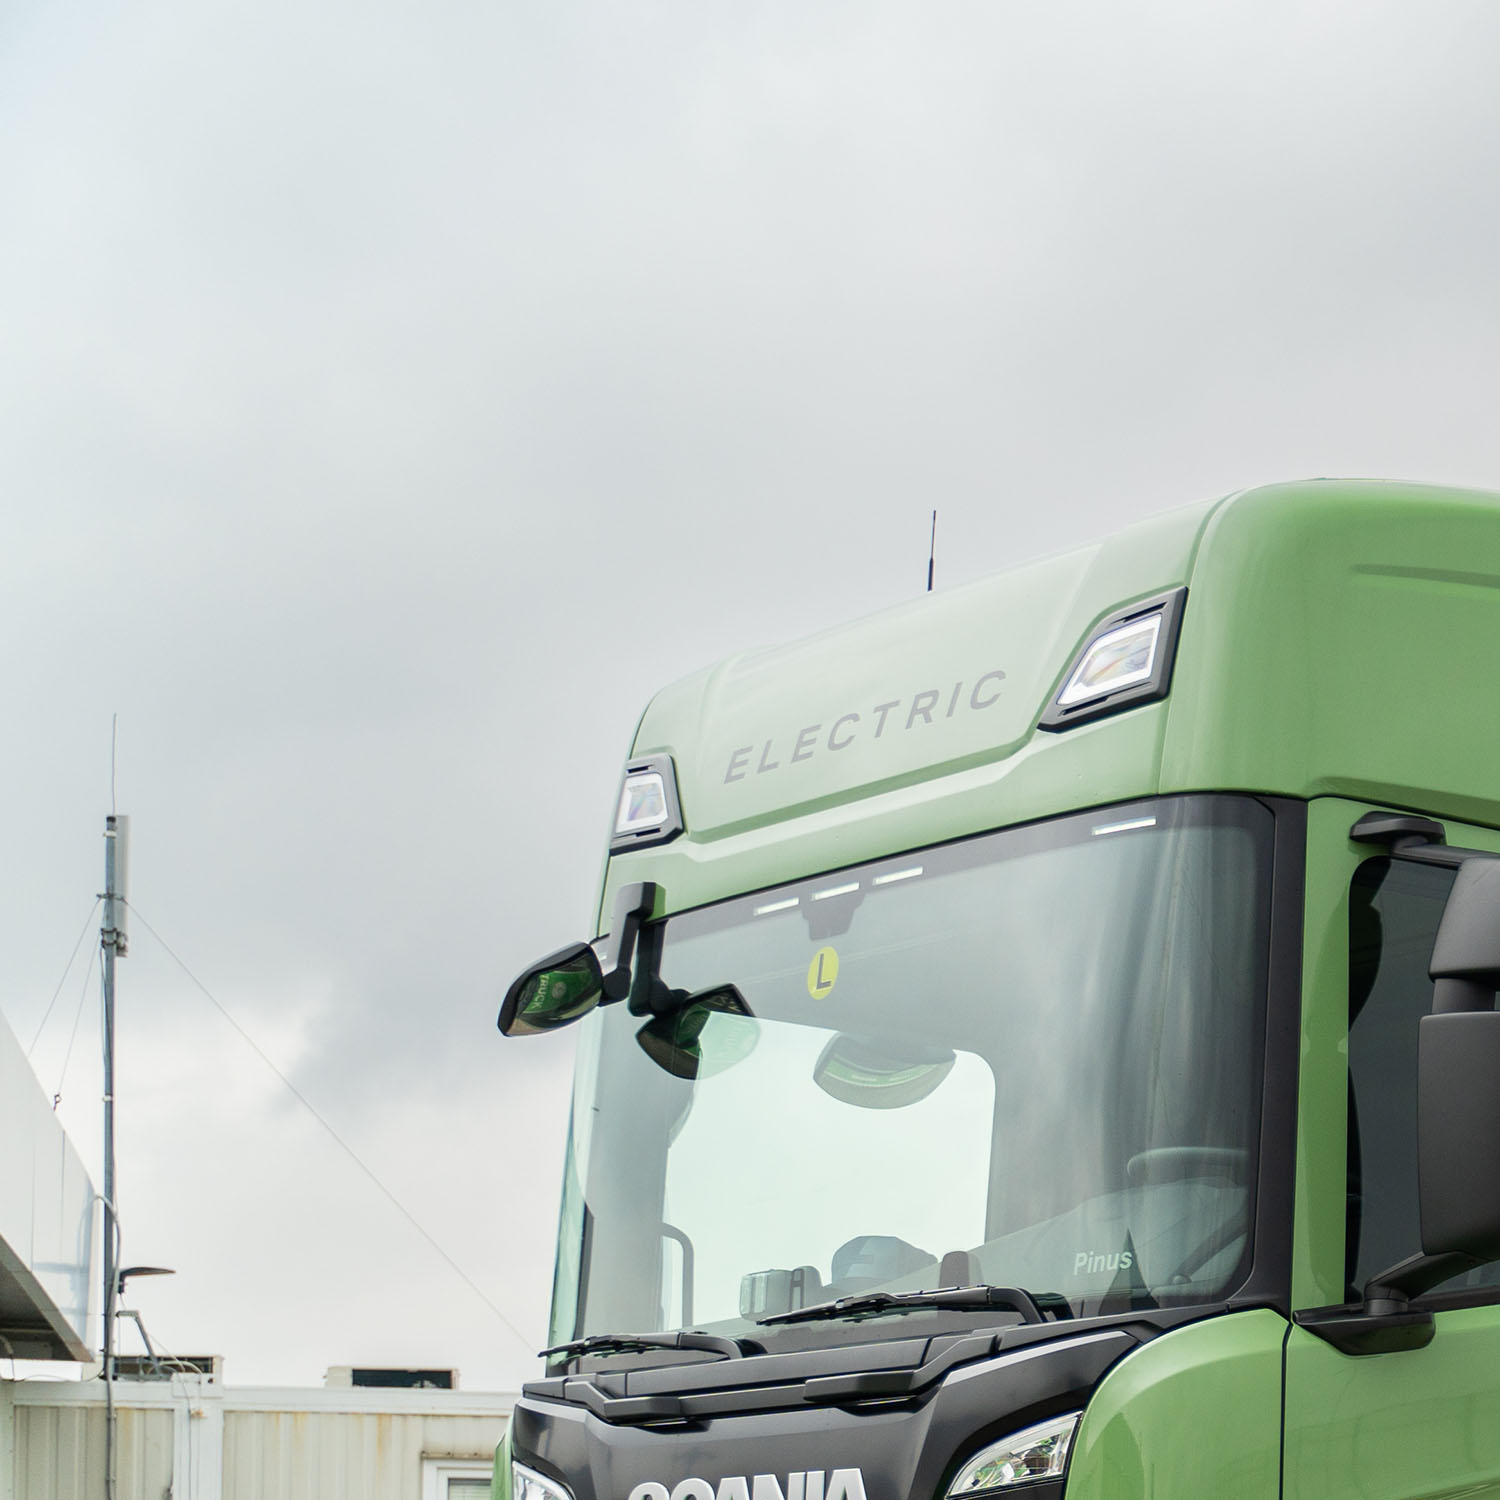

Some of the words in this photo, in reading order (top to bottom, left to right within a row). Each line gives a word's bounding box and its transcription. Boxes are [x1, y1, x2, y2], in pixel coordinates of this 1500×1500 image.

[724, 670, 1006, 785] ELECTRIC
[816, 953, 832, 990] L
[1074, 1250, 1133, 1276] Pinus
